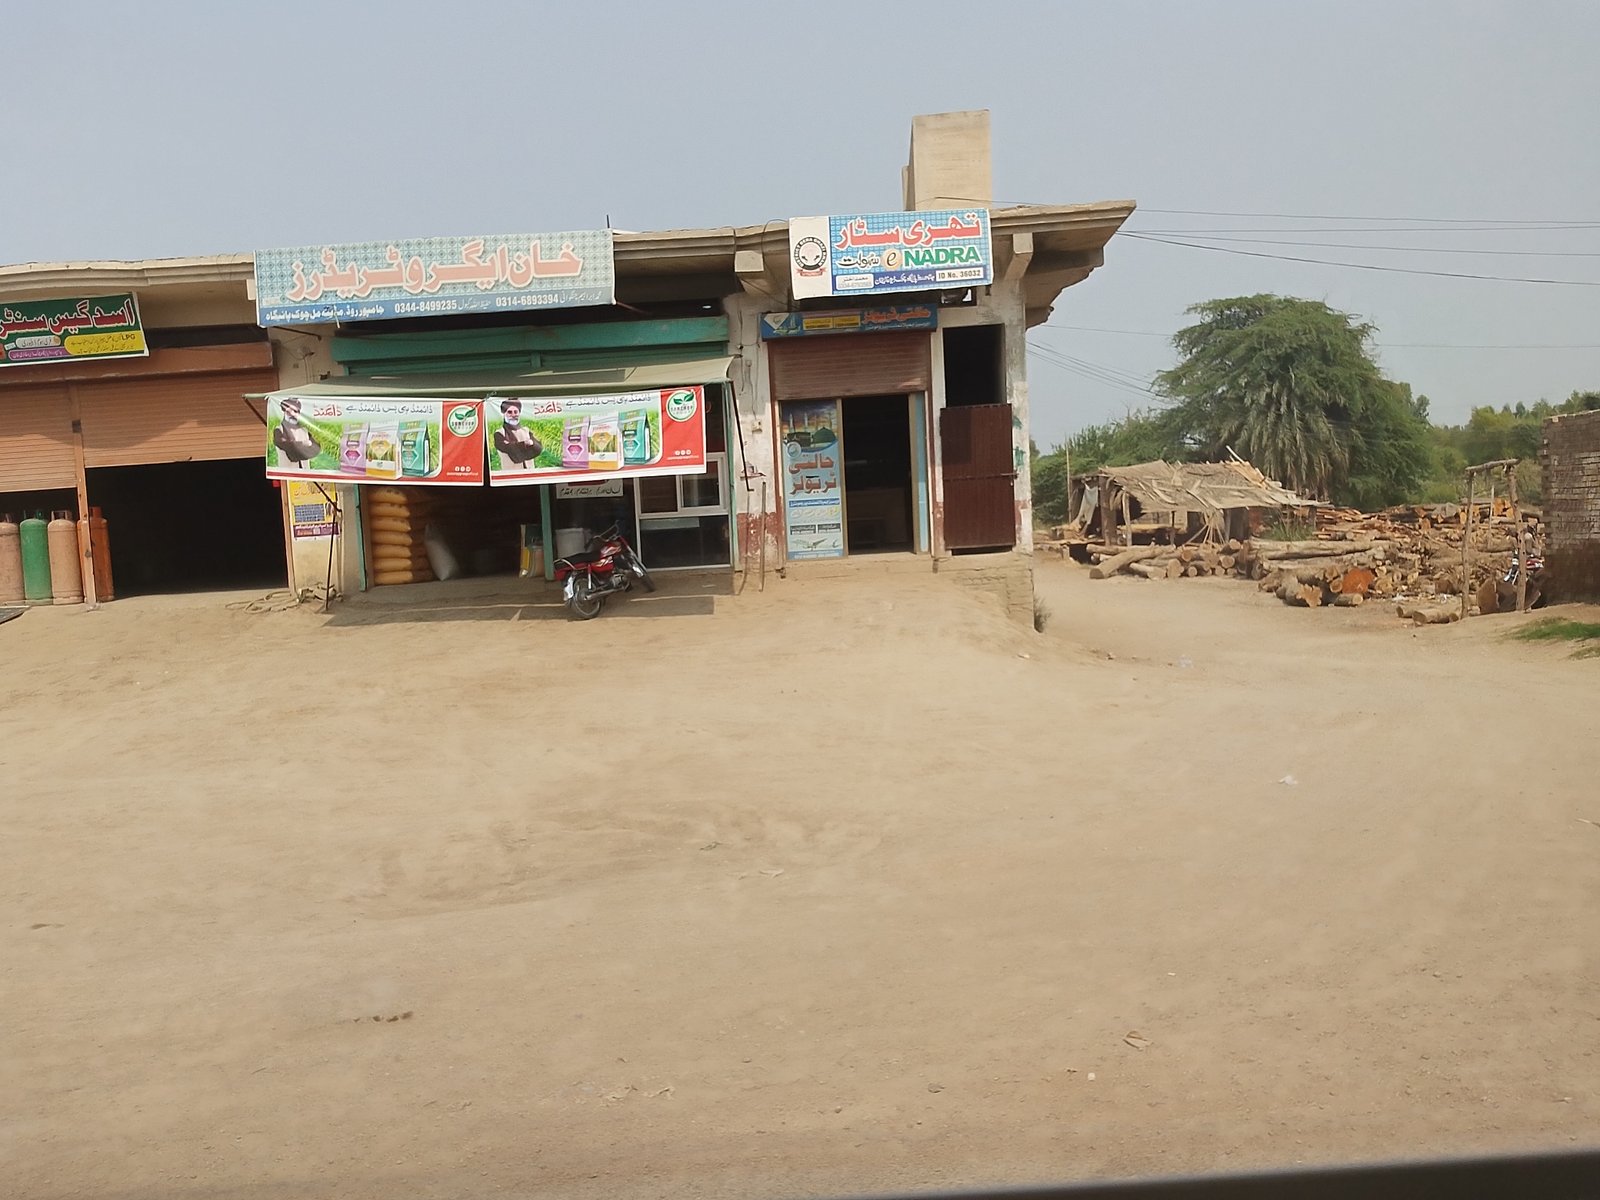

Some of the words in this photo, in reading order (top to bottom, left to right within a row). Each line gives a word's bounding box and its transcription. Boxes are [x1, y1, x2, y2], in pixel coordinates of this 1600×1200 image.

[835, 217, 902, 250] سٹار
[903, 213, 982, 245] تھری
[406, 240, 508, 293] ایگرو
[507, 240, 584, 288] خان
[837, 250, 880, 269] سہولت
[904, 246, 980, 267] NADRA
[287, 246, 406, 302] ٹریڈرز
[947, 271, 959, 279] No.
[48, 299, 94, 336] گیس
[93, 298, 136, 329] اسد
[394, 300, 457, 313] 0344-8499235
[121, 333, 136, 341] LPG
